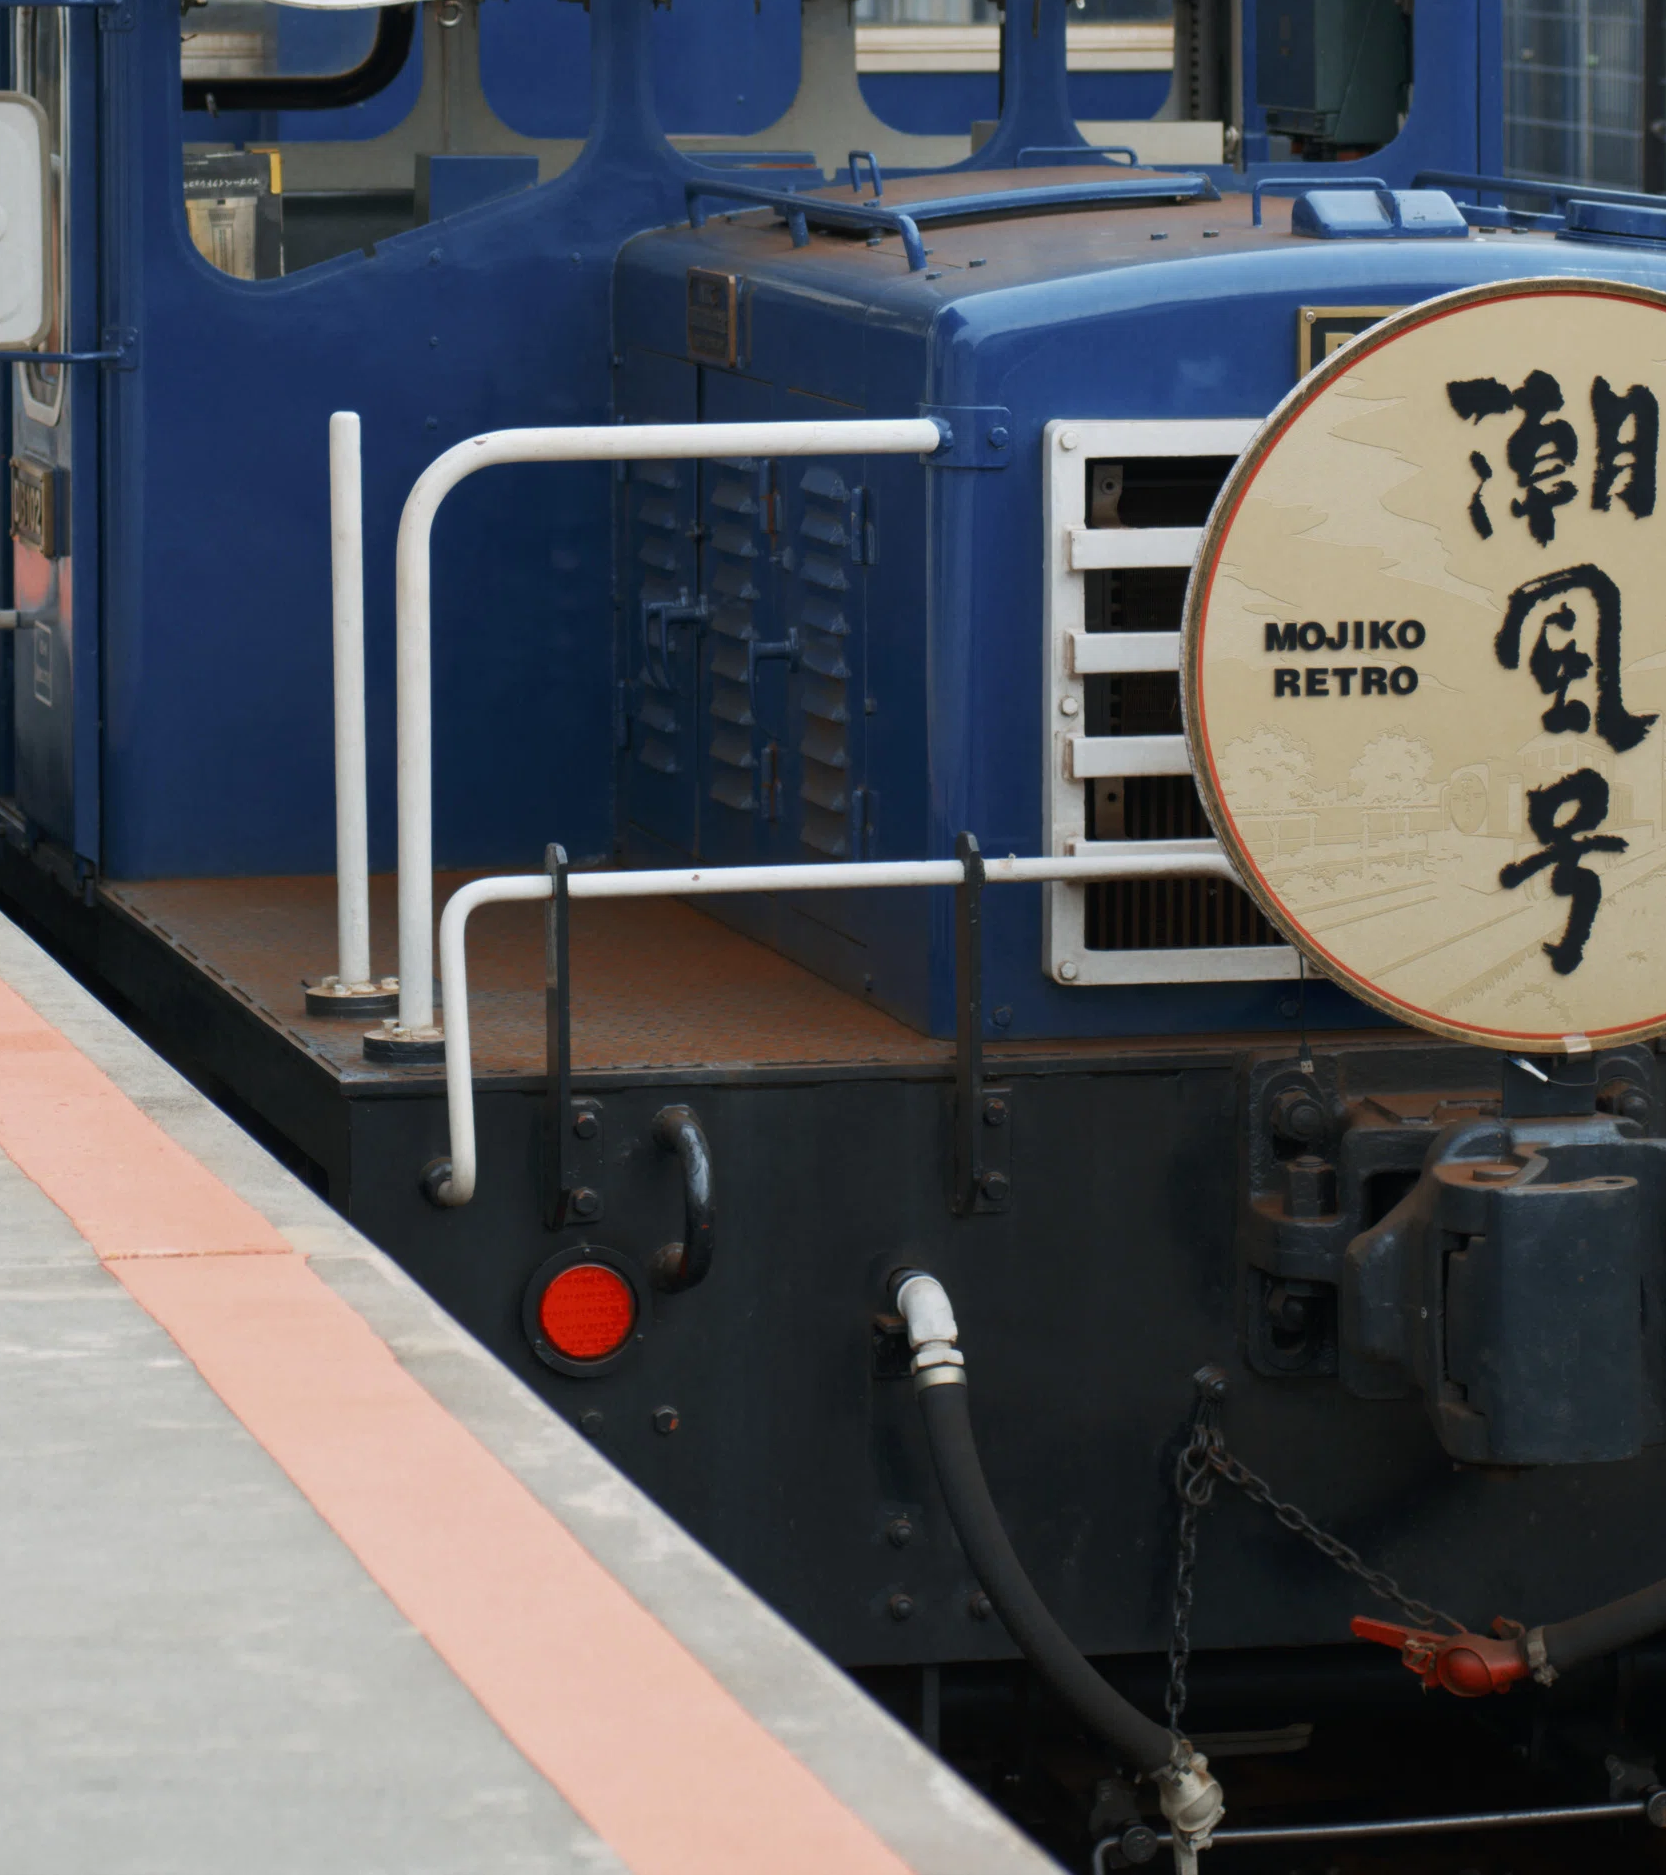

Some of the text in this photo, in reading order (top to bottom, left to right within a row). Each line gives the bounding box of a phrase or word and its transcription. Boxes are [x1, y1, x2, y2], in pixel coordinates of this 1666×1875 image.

[1265, 620, 1425, 651] MOJIKO
[1275, 666, 1418, 697] RETRO
[1447, 370, 1659, 975] 潮風号
